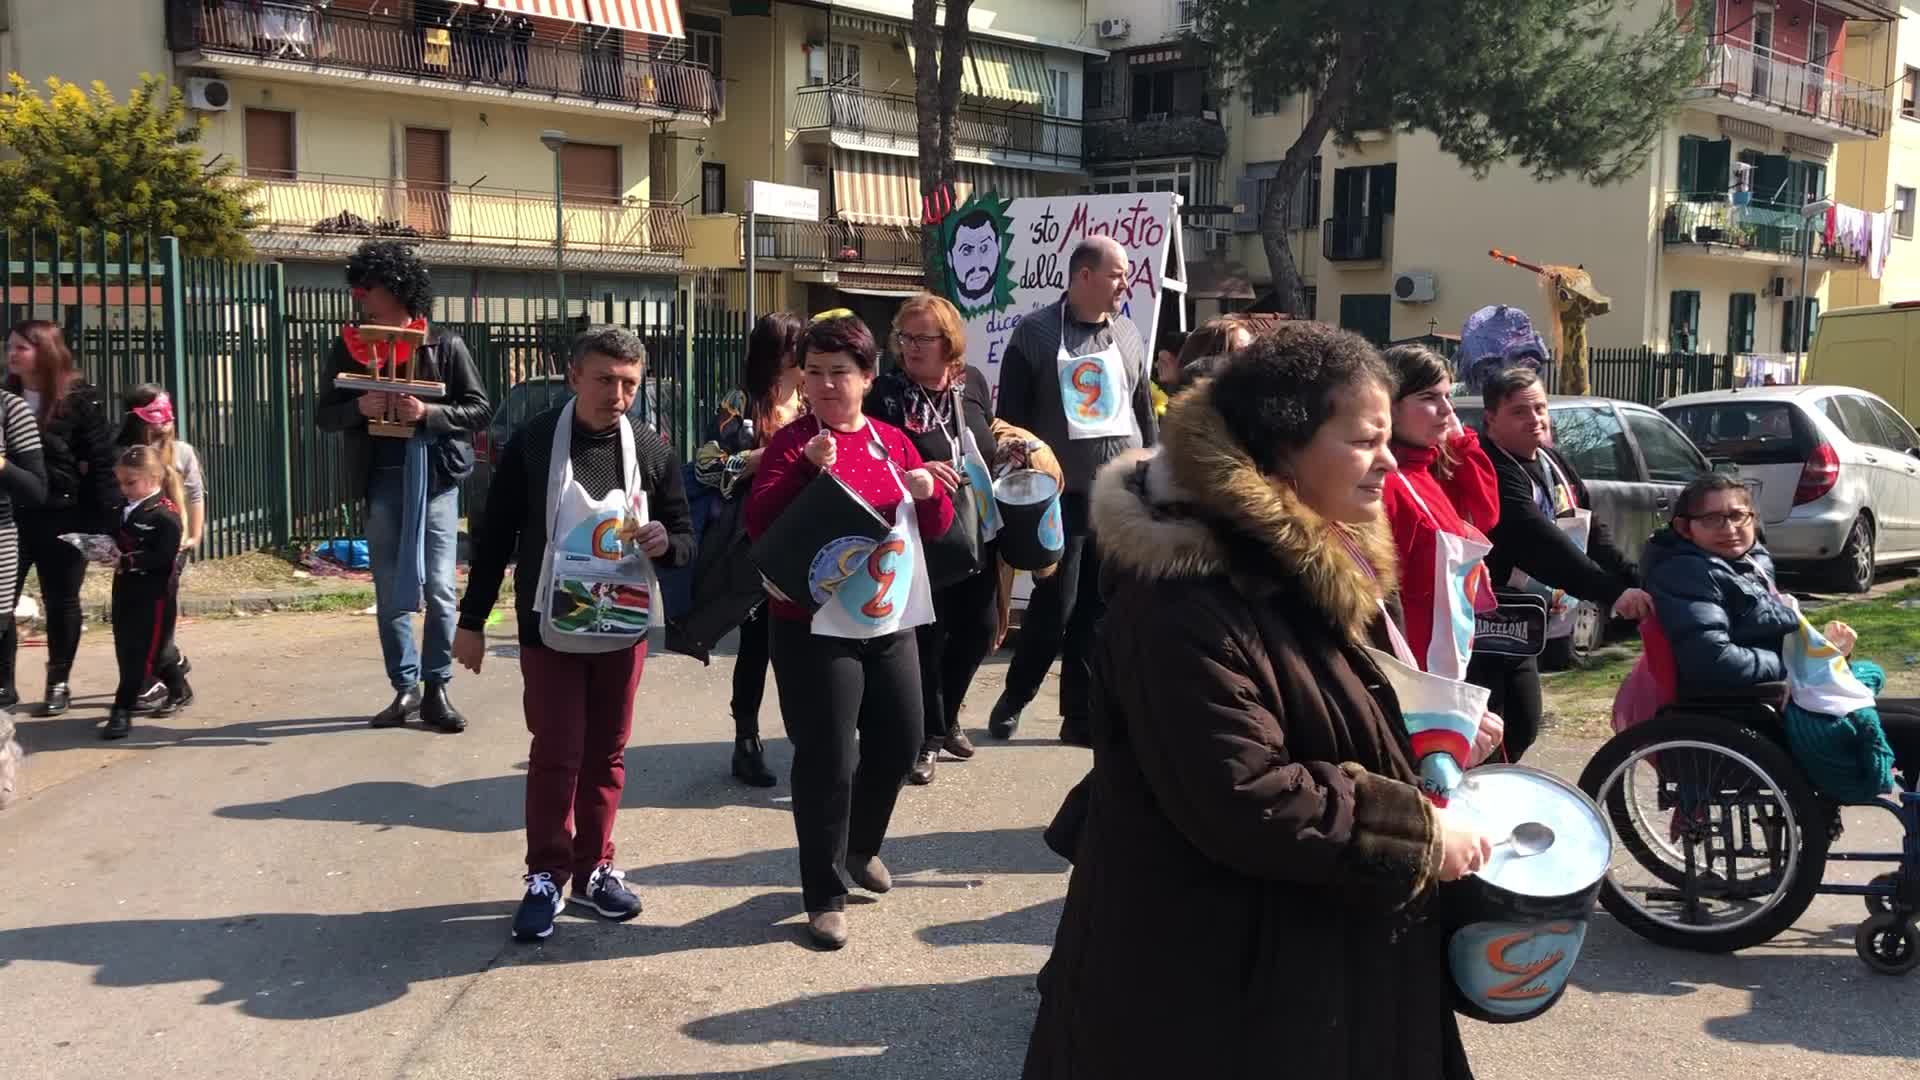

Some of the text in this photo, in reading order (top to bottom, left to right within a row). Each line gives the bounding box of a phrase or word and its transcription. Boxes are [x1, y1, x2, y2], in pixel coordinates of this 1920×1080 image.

[1058, 200, 1163, 253] Ministro
[1020, 253, 1064, 289] della
[986, 296, 1021, 334] dice
[1475, 619, 1529, 640] ARCELONA
